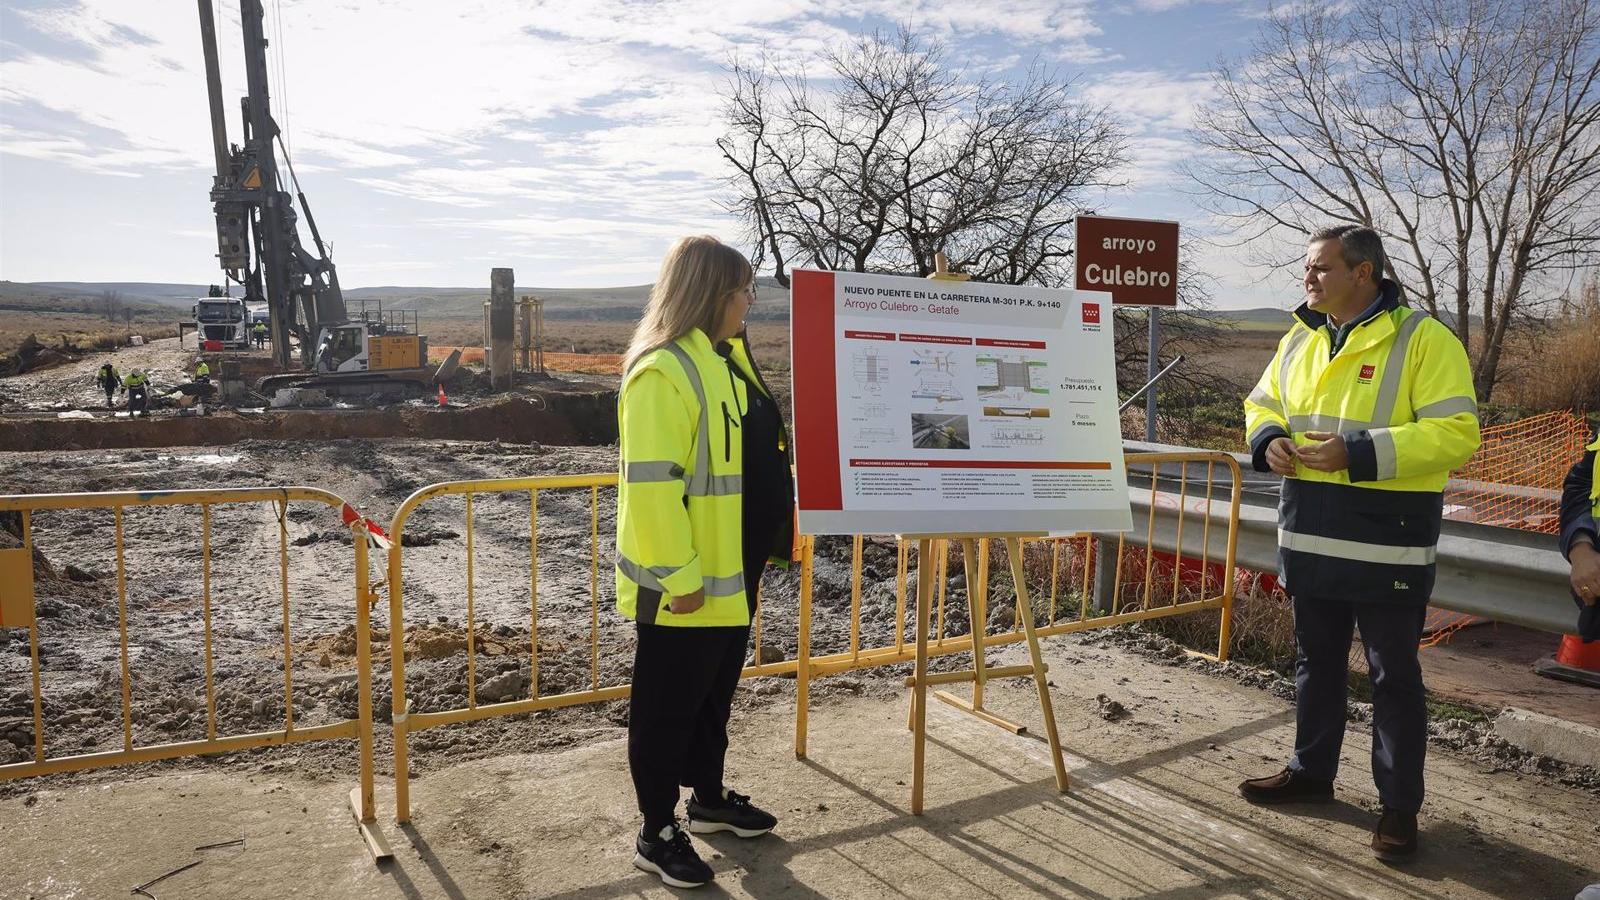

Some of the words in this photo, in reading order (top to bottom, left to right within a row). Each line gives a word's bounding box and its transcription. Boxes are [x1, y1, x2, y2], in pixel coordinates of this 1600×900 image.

[1102, 237, 1156, 254] arroyo
[1085, 263, 1170, 287] Culebro
[844, 286, 875, 296] NUEVO
[877, 288, 911, 298] PUENTE
[914, 291, 926, 299] EN
[928, 292, 939, 300] LA
[940, 293, 991, 304] CARRETERA
[992, 297, 1017, 306] M-301
[1020, 299, 1035, 307] P.K.
[1037, 300, 1061, 309] 9+140
[844, 298, 877, 311] Arroyo
[880, 300, 919, 313] Culebro
[928, 303, 960, 315] Getafe
